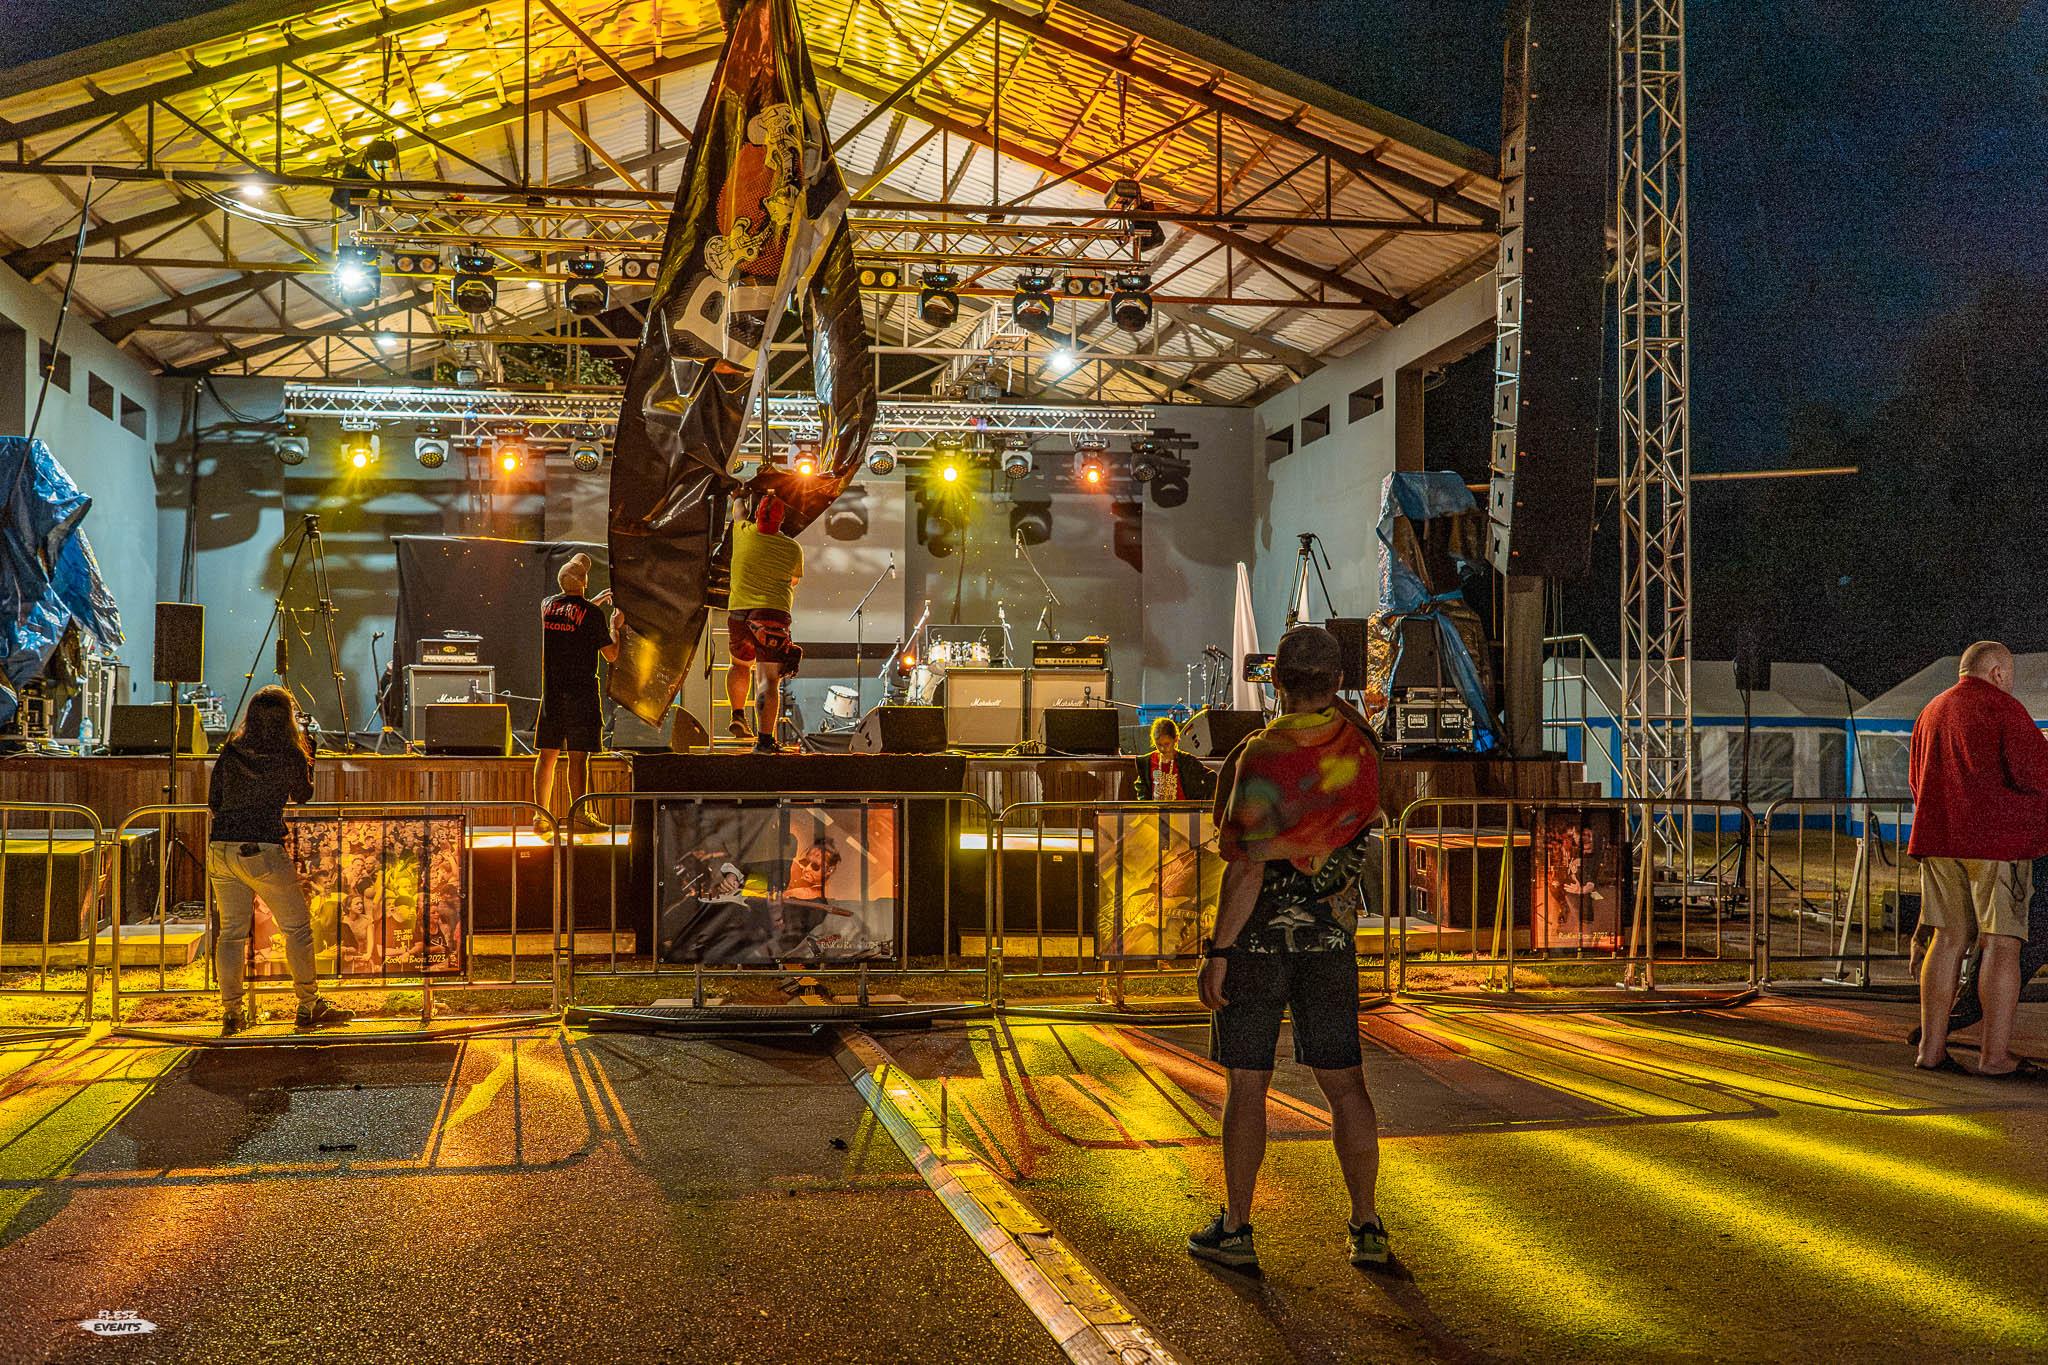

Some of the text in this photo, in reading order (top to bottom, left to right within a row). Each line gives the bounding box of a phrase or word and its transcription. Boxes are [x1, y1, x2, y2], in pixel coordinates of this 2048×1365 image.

[437, 694, 470, 703] Marshall
[970, 698, 1001, 707] Marshall
[1053, 698, 1083, 707] Marshall
[428, 954, 446, 963] 2023
